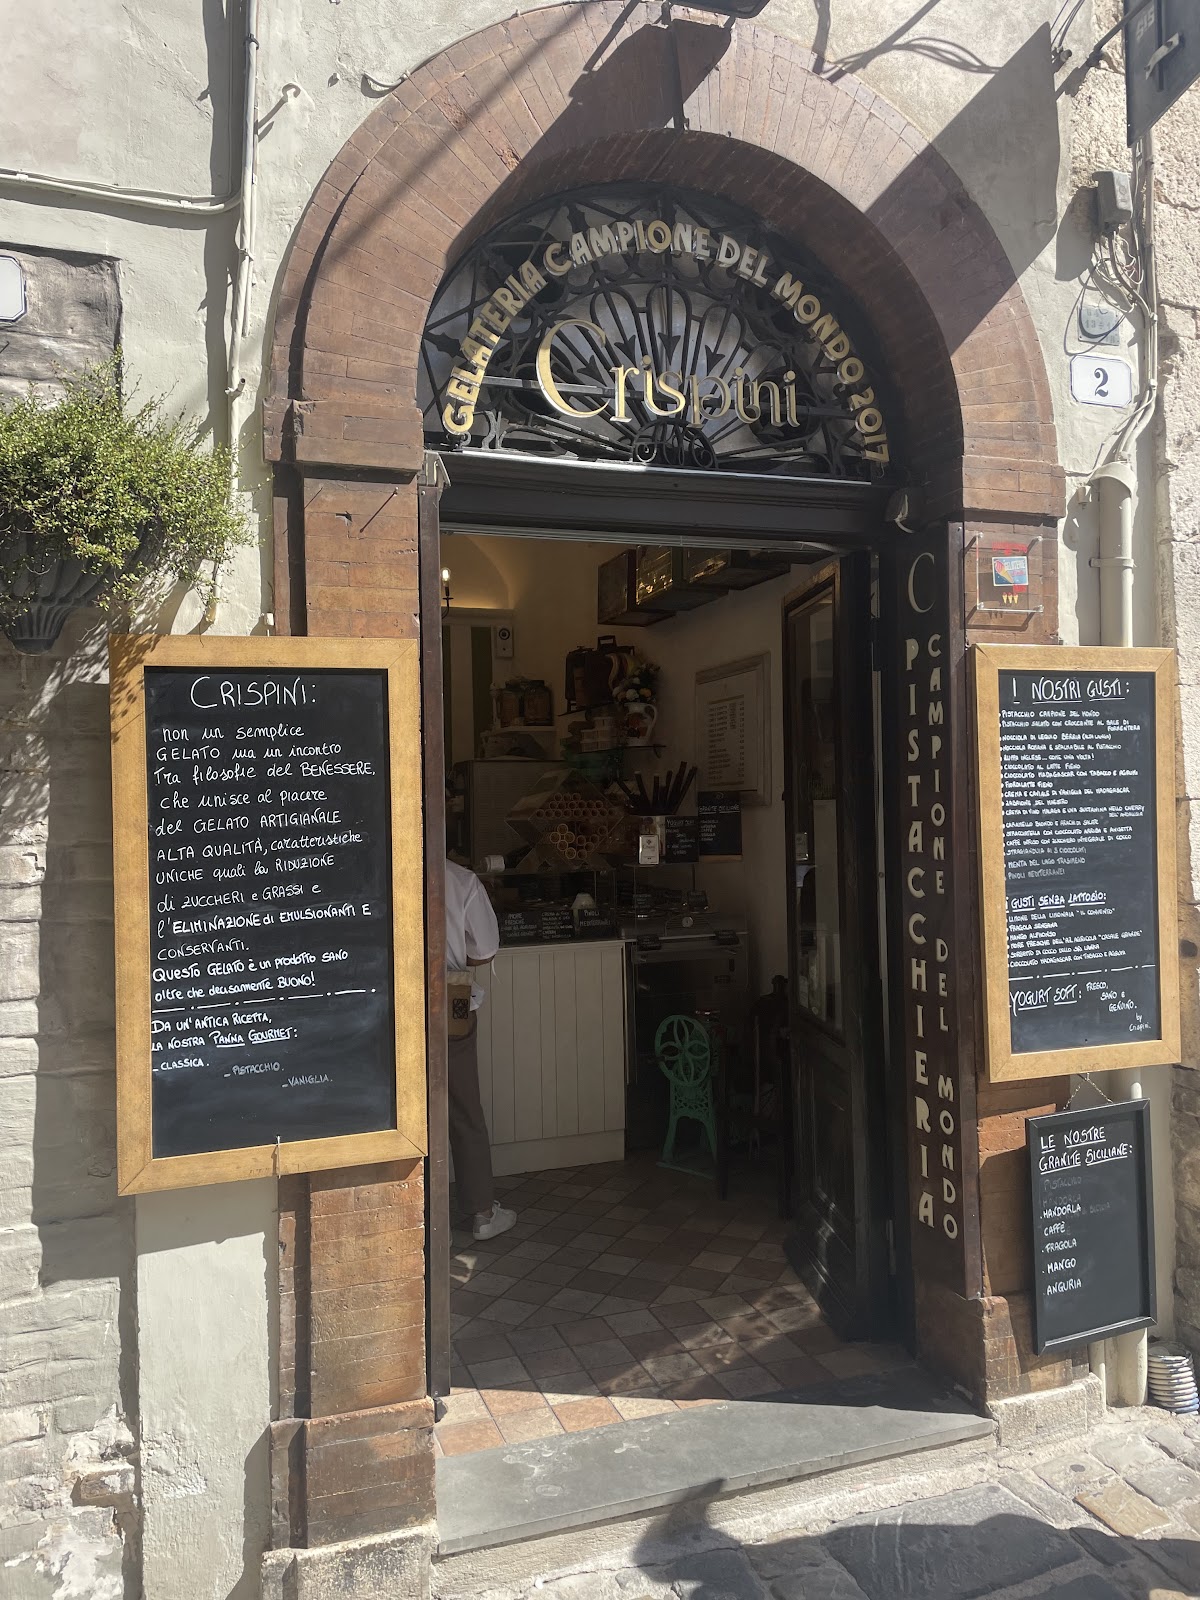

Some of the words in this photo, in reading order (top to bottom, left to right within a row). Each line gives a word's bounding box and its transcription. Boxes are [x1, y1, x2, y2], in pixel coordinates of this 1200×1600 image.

[443, 261, 547, 435] GELATERIA
[544, 220, 711, 276] CAMPIONE
[718, 234, 769, 287] DEL
[775, 271, 864, 385] MONDO
[848, 387, 889, 464] 2017
[536, 319, 800, 427] Crispini
[1094, 368, 1108, 397] 2
[190, 676, 316, 708] CRISPINI:
[1013, 678, 1017, 696] I
[1032, 677, 1081, 700] NOSTRI
[1087, 678, 1130, 697] GUSTI:
[1002, 710, 1035, 718] PISTACCHIO
[163, 727, 189, 742] non
[202, 728, 224, 740] un
[235, 724, 304, 738] semplice
[156, 748, 220, 761] GELATO
[232, 749, 256, 760] ma
[264, 748, 282, 758] un
[289, 743, 341, 757] incontro
[192, 765, 256, 785] filosofie
[267, 765, 293, 776] del
[301, 761, 375, 777] BENESSERE,
[927, 633, 945, 896] CAMPIONE
[160, 792, 189, 809] che
[198, 793, 250, 808] unisce
[258, 793, 271, 803] al
[280, 790, 327, 803] piacere
[156, 821, 182, 836] del
[194, 817, 248, 834] GELATO
[260, 811, 341, 828] ARTIGIANALE
[157, 847, 195, 862] ALTA
[156, 868, 203, 885] UNICHE
[213, 865, 246, 881] quali
[255, 863, 268, 875] la
[275, 855, 334, 872] RIDUZIONE
[157, 894, 175, 913] di
[181, 891, 243, 909] ZUCCHERI
[252, 892, 258, 901] e
[262, 884, 303, 901] GRASSI
[312, 883, 321, 893] e
[1011, 895, 1034, 909] GUSTI
[1038, 894, 1065, 906] SENZA
[262, 913, 274, 925] di
[280, 906, 355, 923] EMULSIONANTI
[362, 904, 371, 915] E
[906, 637, 933, 1230] PISTACCHIERIA
[1009, 924, 1032, 932] FRAGOLA
[157, 937, 249, 961] CONSERVANTI.
[206, 960, 244, 975] GELATO
[248, 959, 257, 972] è
[259, 959, 271, 970] un
[321, 949, 348, 963] SANO
[155, 986, 183, 1002] oltre
[187, 986, 206, 998] che
[278, 972, 315, 989] BUONO!
[936, 938, 949, 1032] DEL
[1101, 992, 1117, 1000] SANO
[1010, 987, 1052, 1016] YOGURT
[152, 1020, 171, 1034] DA
[232, 1012, 271, 1025] RICETTA,
[1136, 1013, 1142, 1022] by
[152, 1039, 163, 1052] LA
[168, 1035, 205, 1050] NOSTRA
[209, 1031, 245, 1046] PANNA
[1041, 1134, 1055, 1149] LE
[1064, 1126, 1106, 1144] NOSTRE
[937, 1076, 957, 1240] MONDO
[1039, 1150, 1081, 1171] GRANITE
[1043, 1204, 1081, 1219] MANDORLA
[1044, 1221, 1065, 1236] CAFFÈ
[1045, 1239, 1077, 1252] FRAGOLA
[1048, 1259, 1076, 1273] MANGO
[1047, 1279, 1081, 1295] ANGURIA
